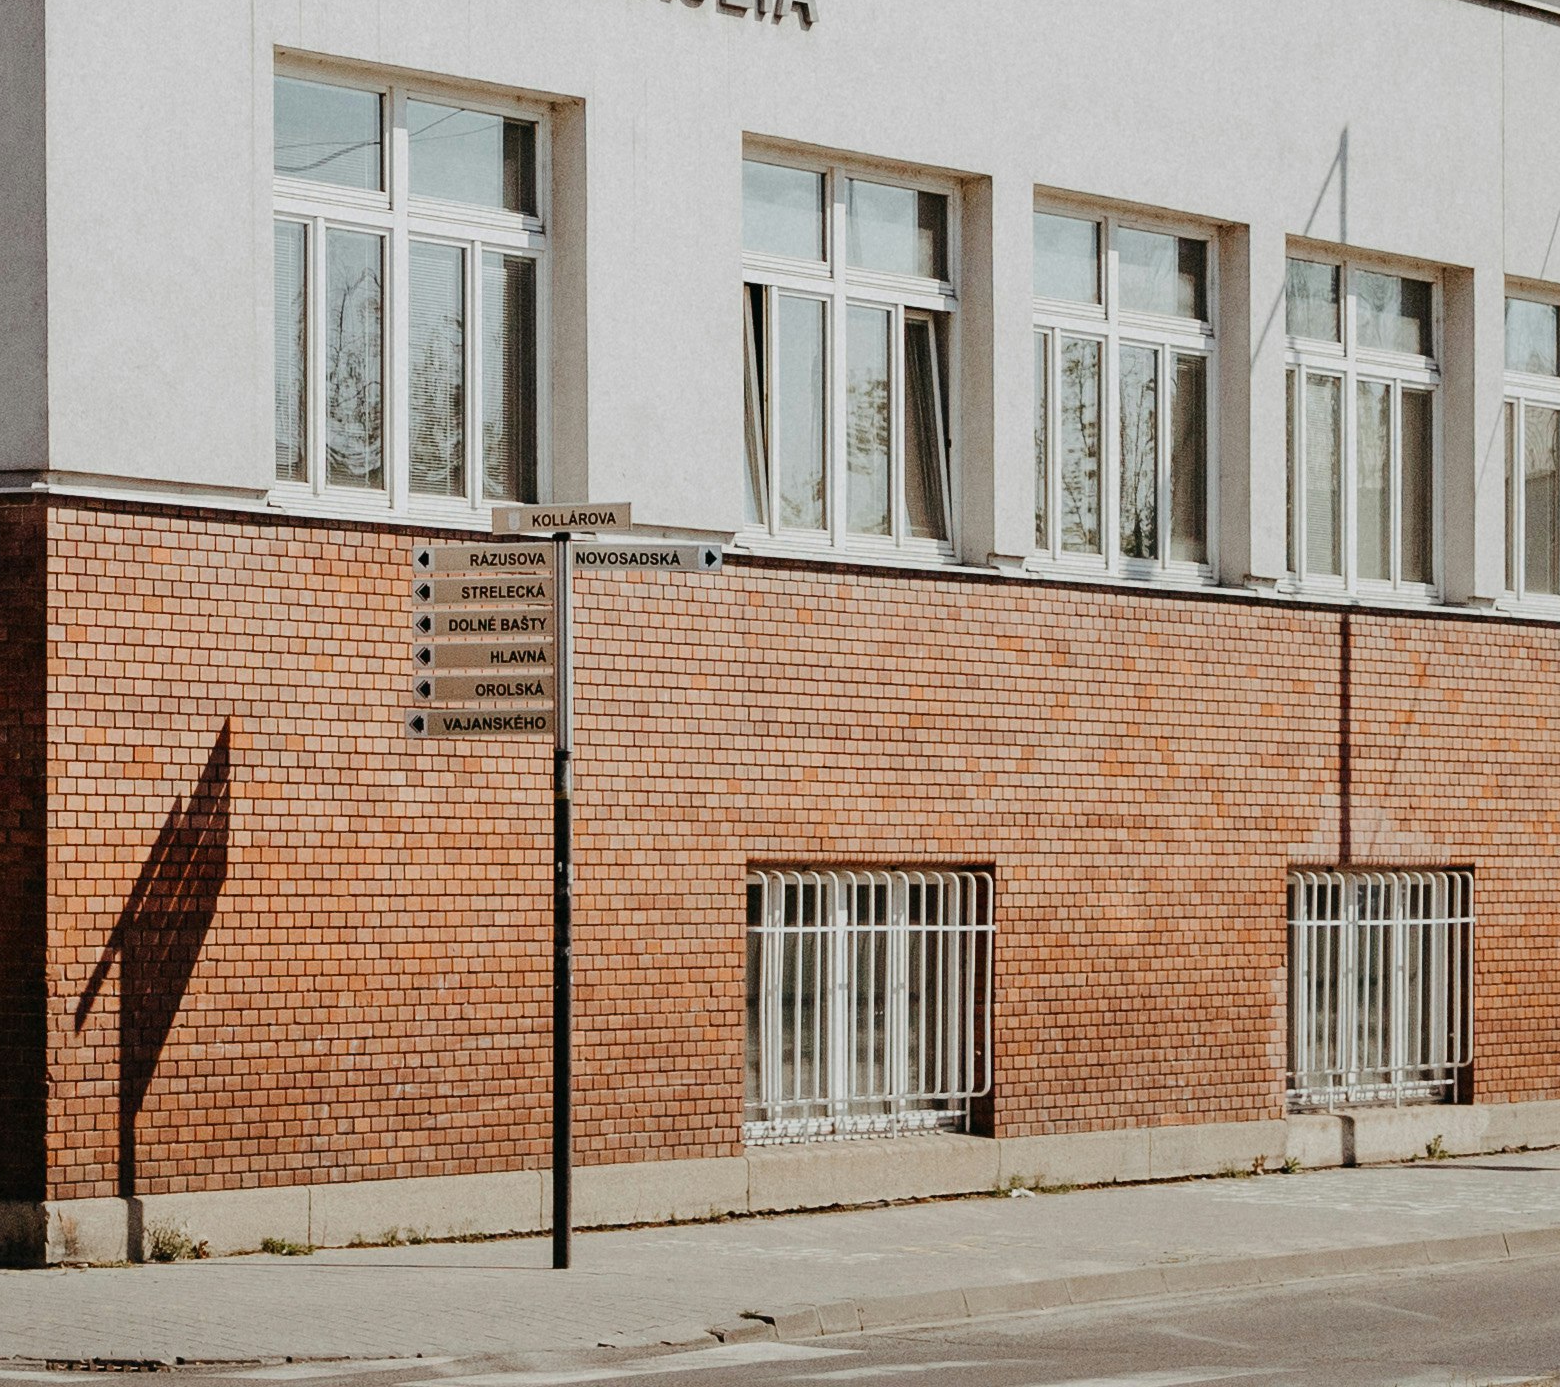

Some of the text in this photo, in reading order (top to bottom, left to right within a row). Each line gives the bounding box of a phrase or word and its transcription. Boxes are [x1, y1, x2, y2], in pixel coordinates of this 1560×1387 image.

[531, 510, 617, 527] KOLLÁROVA
[469, 550, 546, 566] RÁZUSOVA
[575, 549, 681, 566] NOVOSADSKÁ
[461, 582, 546, 600] STRELECKÁ
[448, 615, 547, 632] DOLNÉ BAŠTY
[490, 647, 547, 664] HLAVNÁ
[474, 680, 545, 697] OROLSKÁ
[442, 714, 547, 732] VAJANSKÉHO
